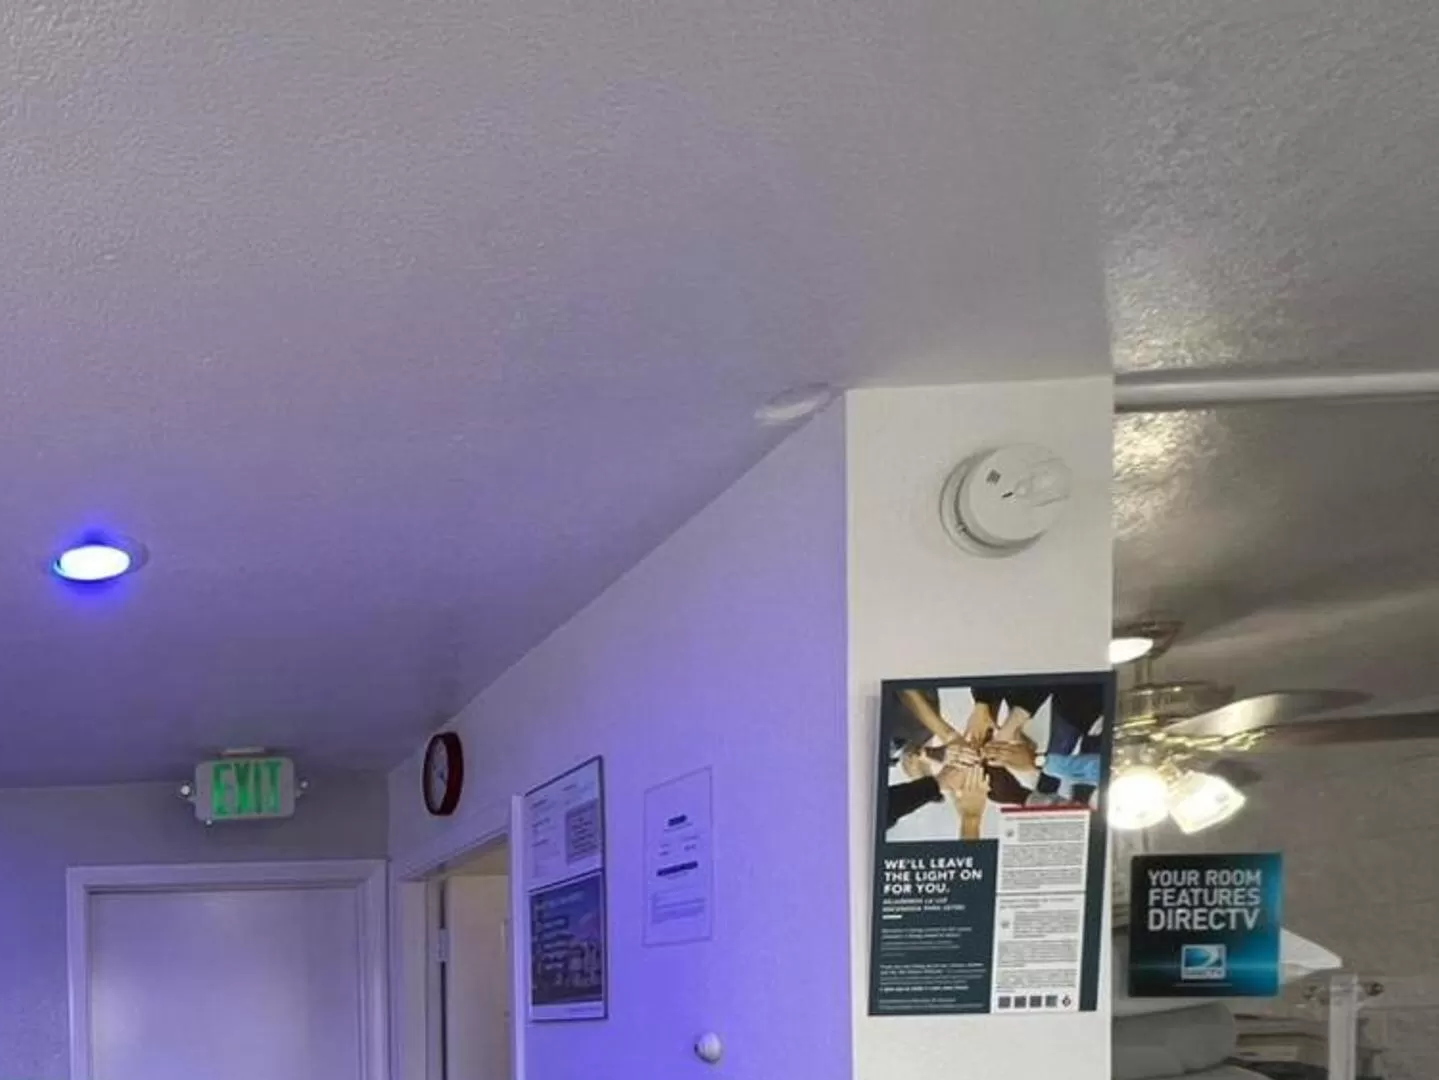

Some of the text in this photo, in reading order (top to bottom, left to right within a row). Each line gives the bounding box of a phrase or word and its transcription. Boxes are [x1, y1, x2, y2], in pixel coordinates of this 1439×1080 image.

[212, 761, 282, 816] EXIT
[884, 857, 974, 870] WE'LL LEAVE
[884, 869, 983, 882] THE LIGHT ON
[1147, 869, 1262, 887] YOUR ROOM
[883, 882, 951, 894] FOR YOU.
[1148, 887, 1261, 907] FEATURES
[1148, 908, 1261, 931] DIRECTV
